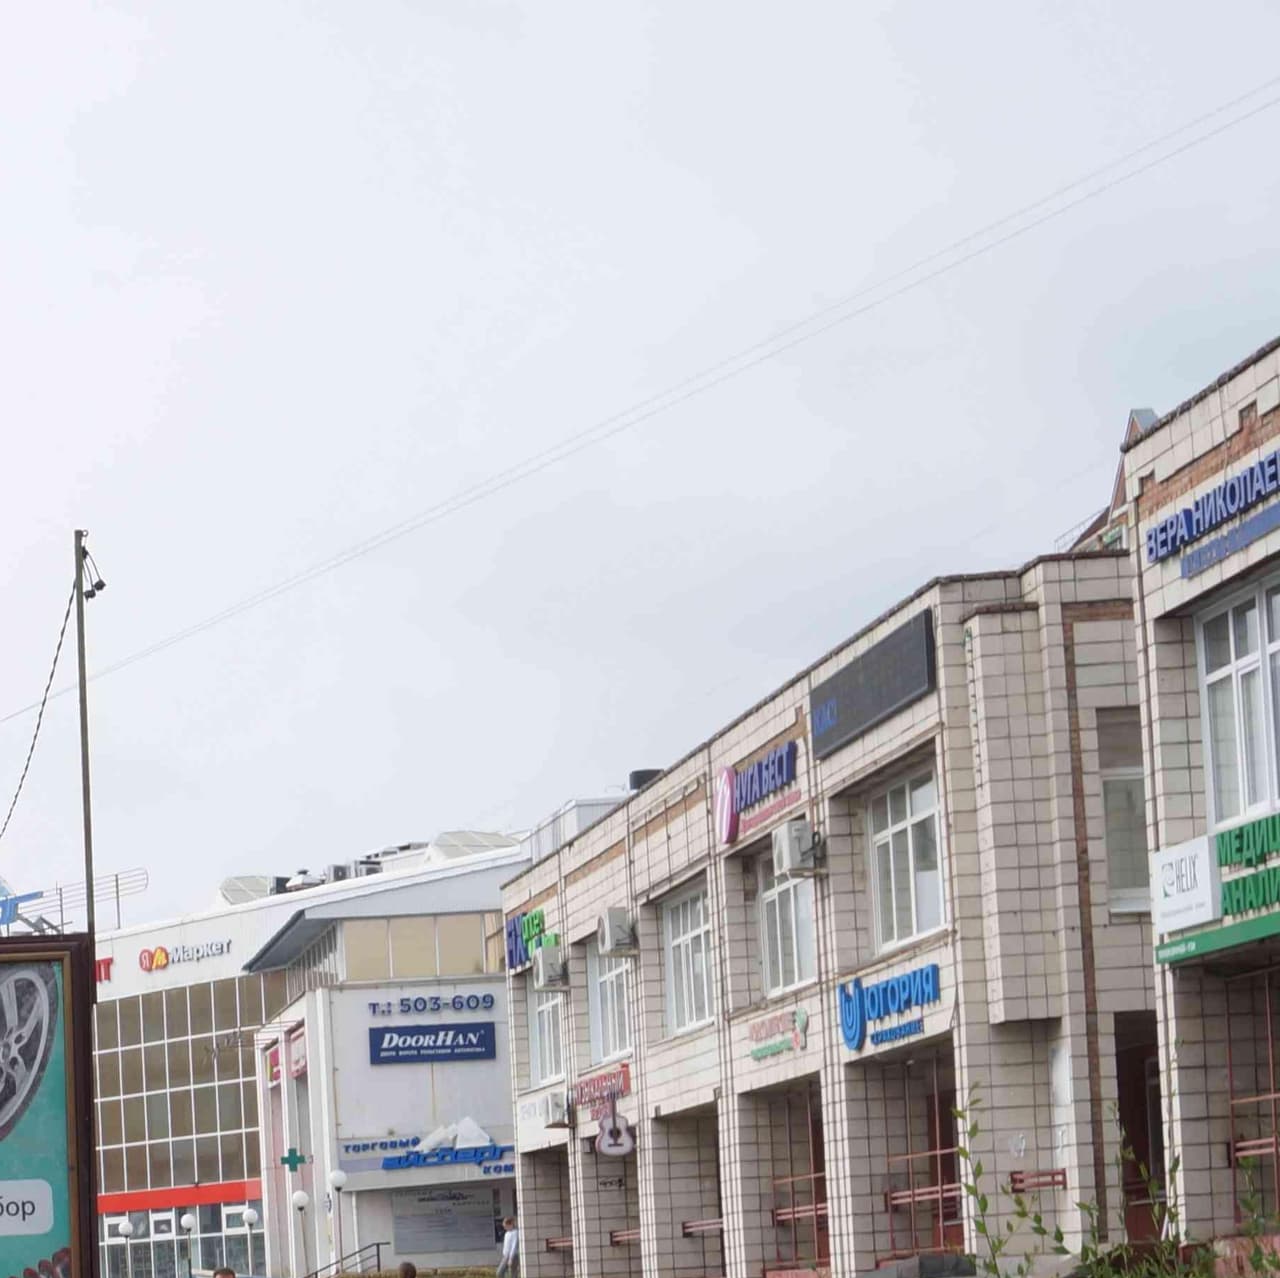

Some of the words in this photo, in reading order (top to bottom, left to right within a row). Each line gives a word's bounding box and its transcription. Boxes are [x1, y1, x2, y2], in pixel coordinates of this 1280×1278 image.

[1146, 511, 1189, 563] ВЕРА
[1192, 450, 1280, 536] НИКОЛАЕ
[734, 762, 761, 814] НУГА
[761, 743, 790, 796] БЕСТ
[1175, 854, 1199, 894] HELIX
[171, 938, 232, 964] Маркет
[399, 994, 495, 1014] 503-609
[864, 965, 936, 1020] ЮГОРИЯ
